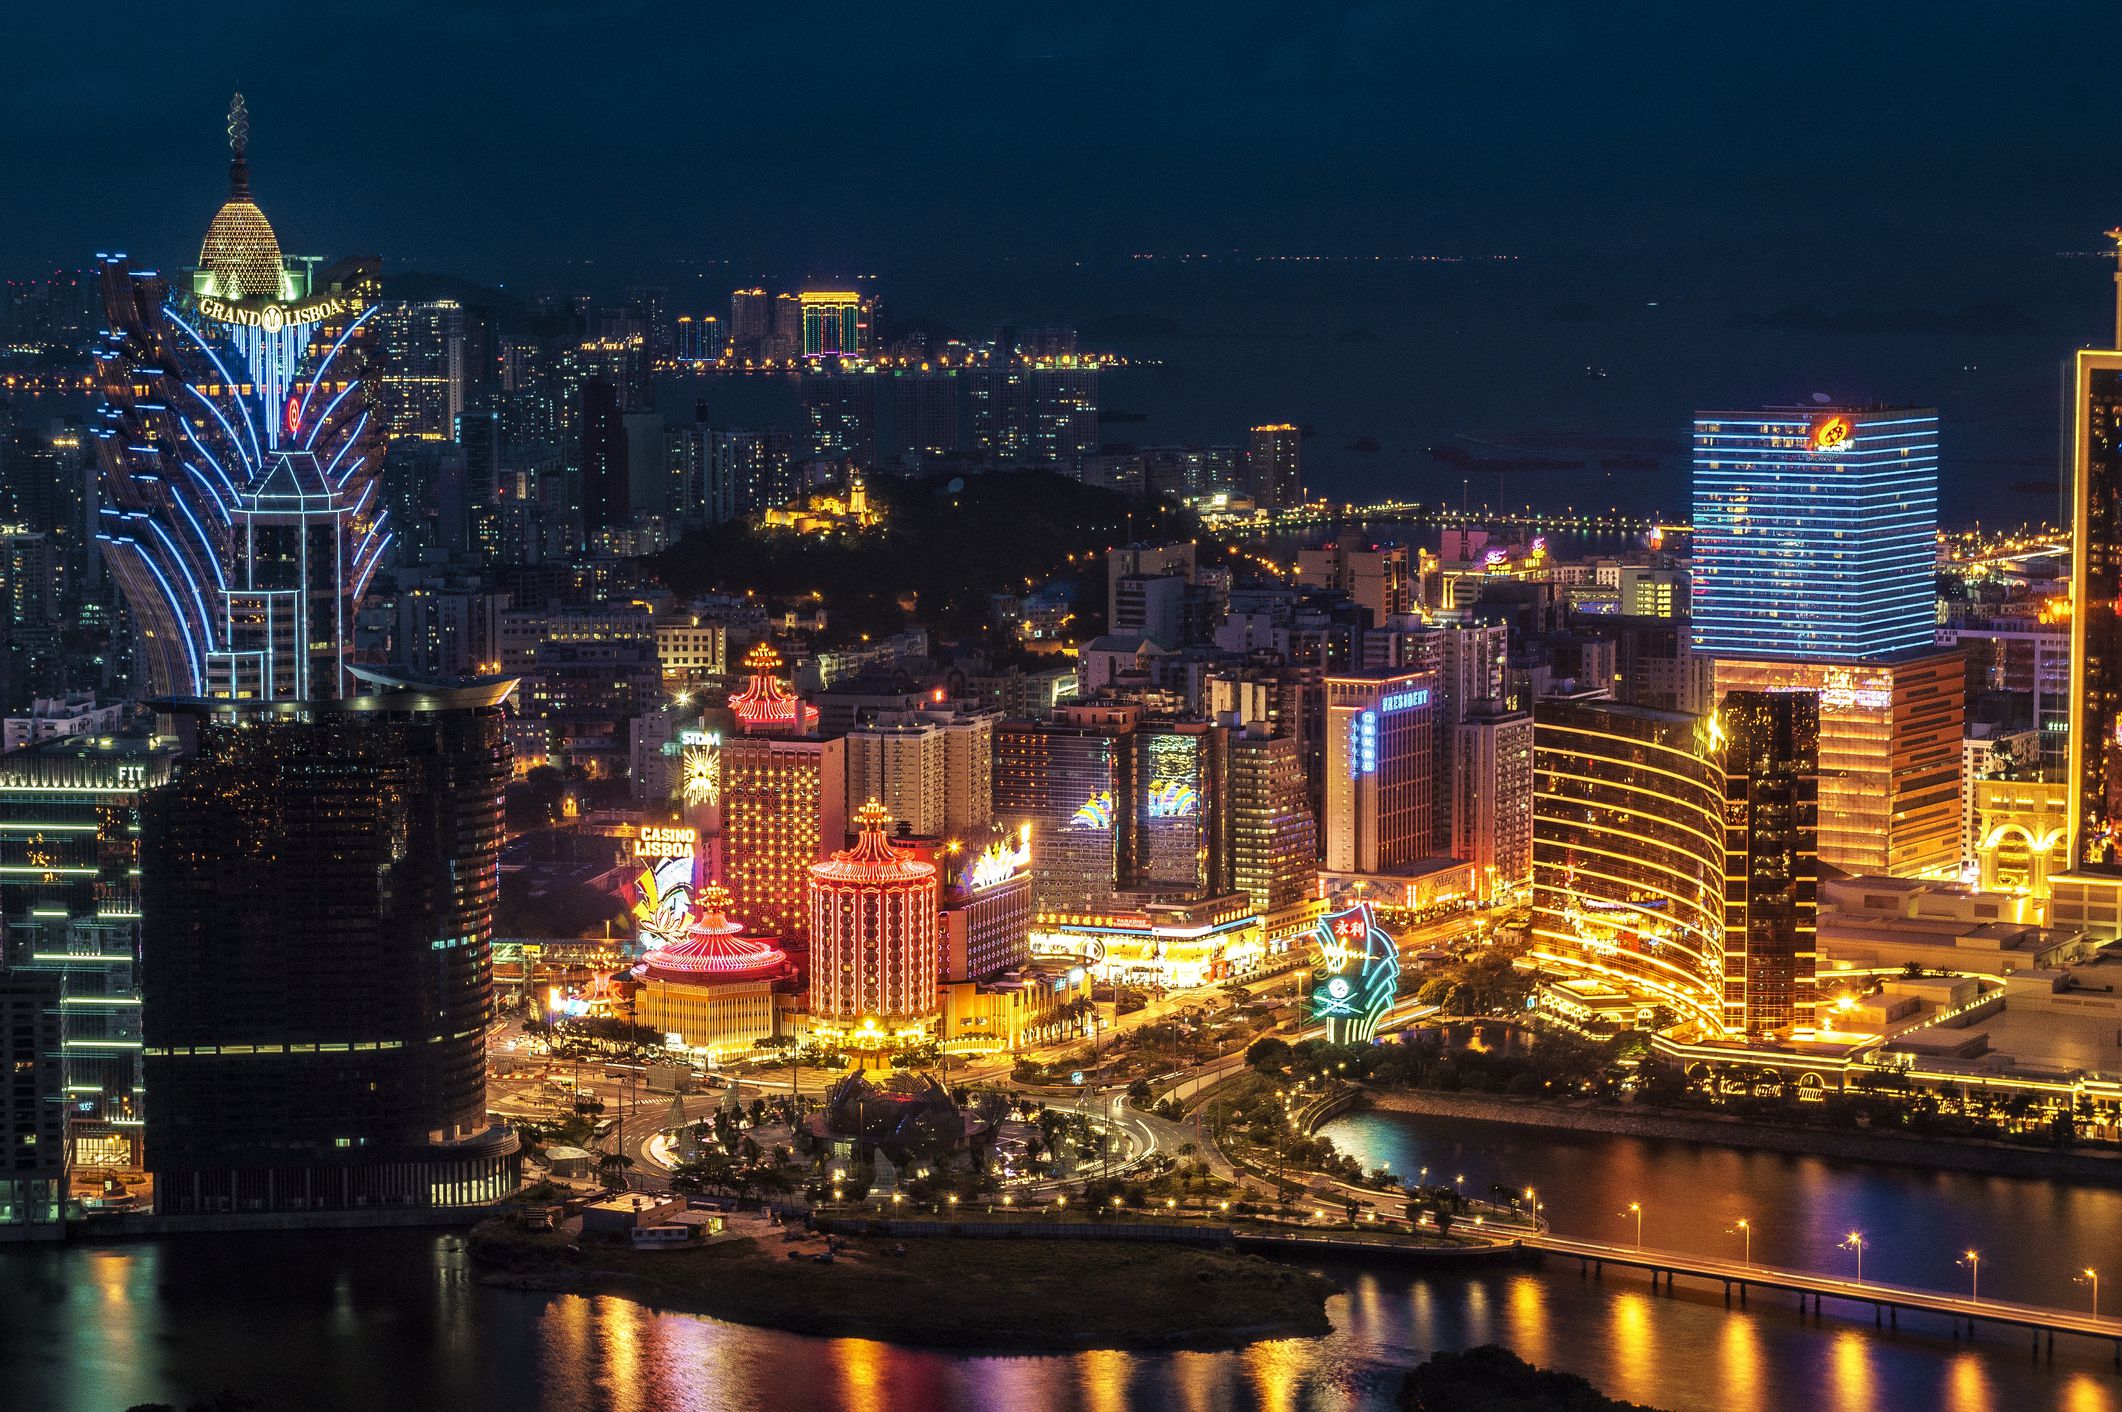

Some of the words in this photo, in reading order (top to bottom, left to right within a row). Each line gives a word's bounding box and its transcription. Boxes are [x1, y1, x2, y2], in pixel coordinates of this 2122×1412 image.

[200, 299, 262, 327] GRAND
[284, 299, 345, 326] LISBOA
[1382, 689, 1429, 713] PRESIDENT
[682, 730, 721, 746] STDM
[118, 766, 145, 781] FIT
[641, 826, 695, 842] CASINO
[634, 841, 694, 858] LISBOA
[1335, 919, 1366, 938] 永利
